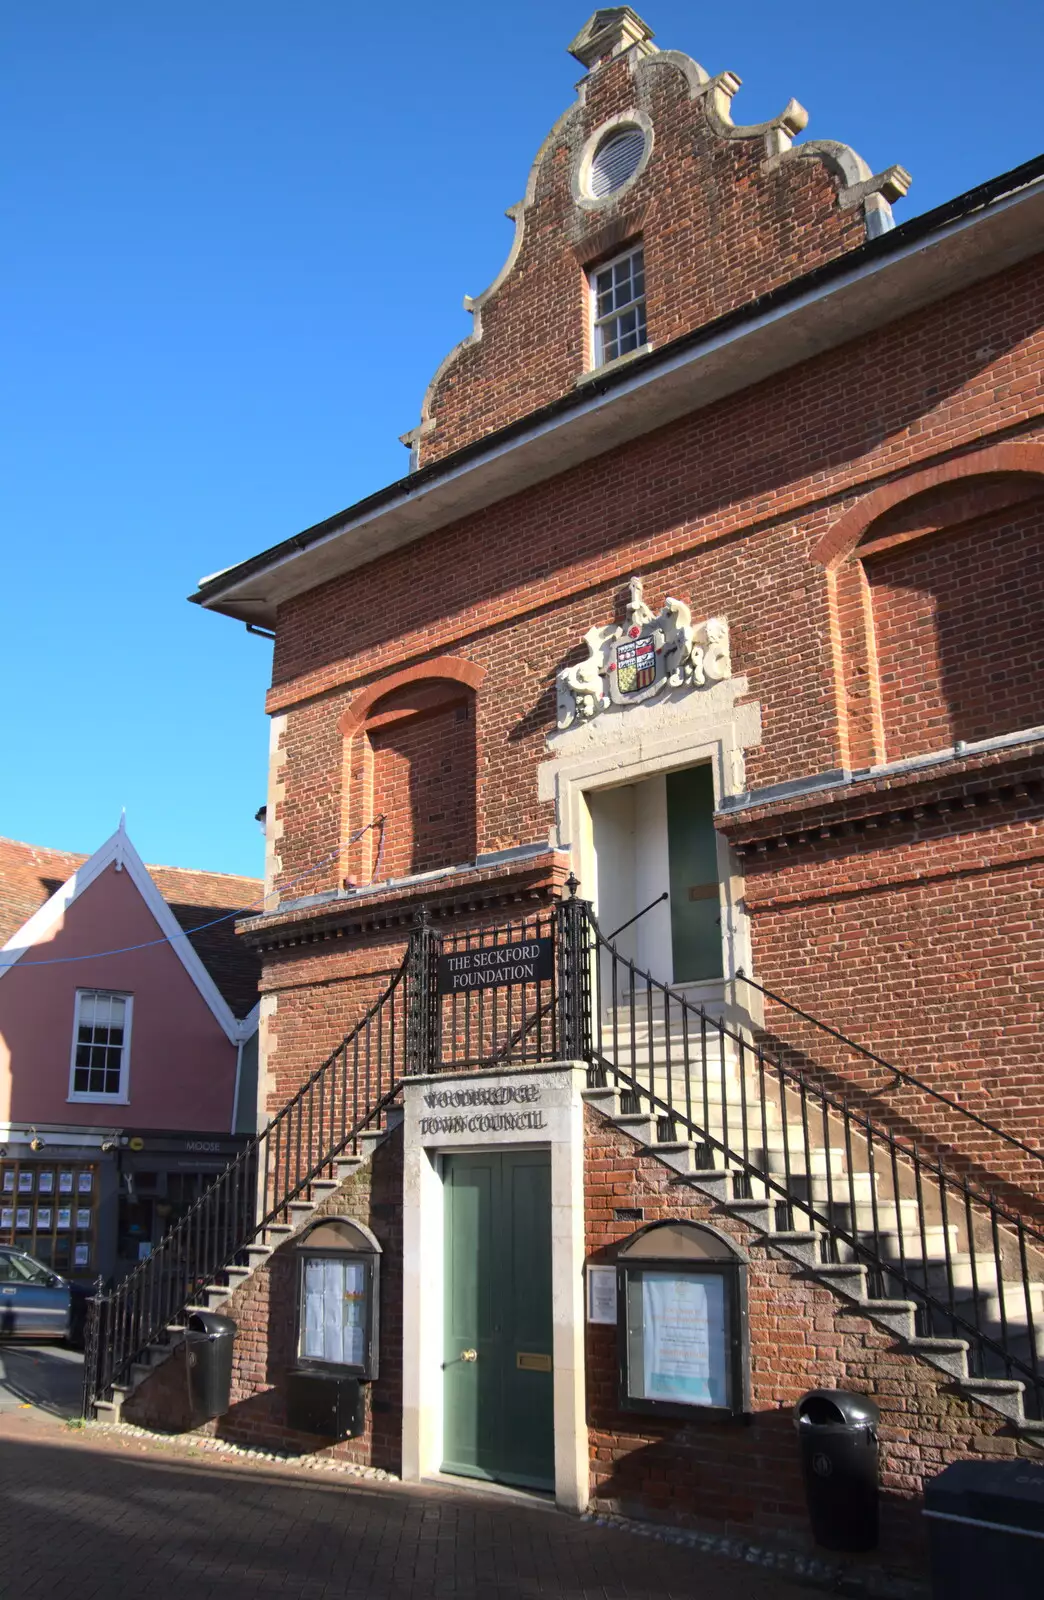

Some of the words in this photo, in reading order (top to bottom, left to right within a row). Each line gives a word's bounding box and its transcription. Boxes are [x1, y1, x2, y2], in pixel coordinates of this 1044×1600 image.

[448, 956, 471, 971] THE
[473, 944, 540, 967] SECKFORD
[453, 964, 534, 988] FOUNDATION
[423, 1084, 541, 1109] WOODBRIDGE
[419, 1114, 468, 1135] TOWN
[468, 1110, 548, 1133] COUNCIL
[186, 1141, 220, 1151] MOOSE
